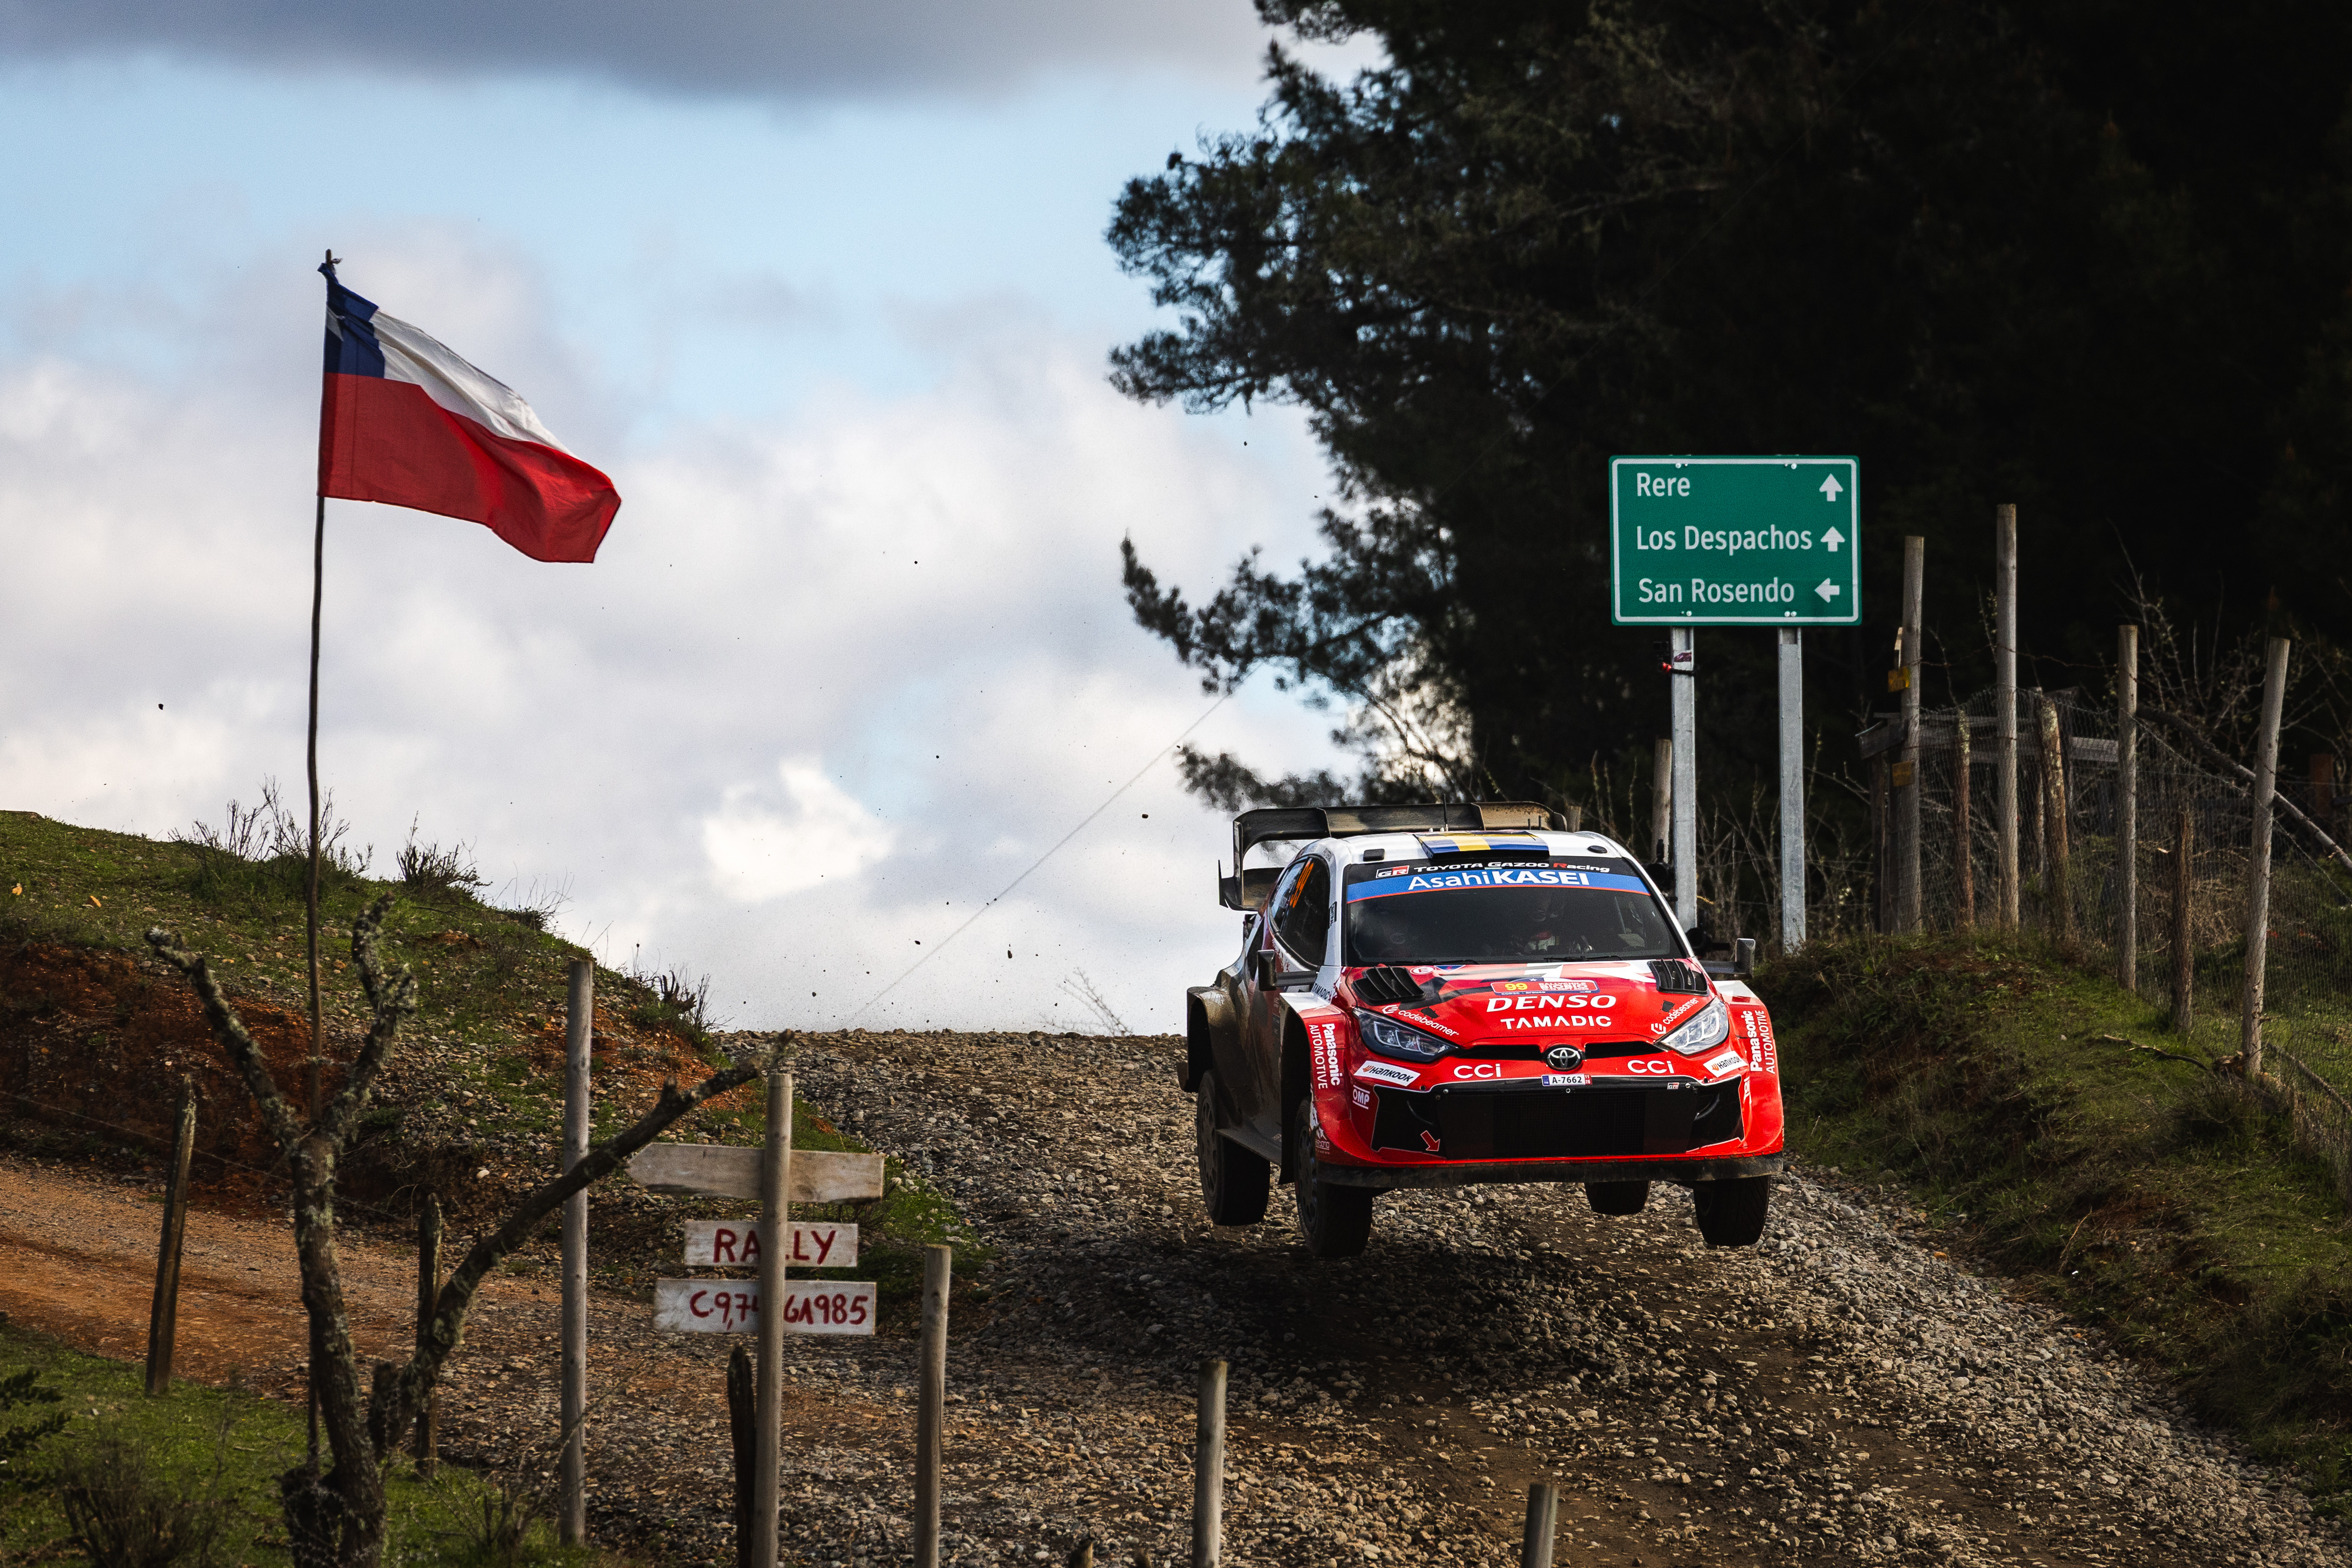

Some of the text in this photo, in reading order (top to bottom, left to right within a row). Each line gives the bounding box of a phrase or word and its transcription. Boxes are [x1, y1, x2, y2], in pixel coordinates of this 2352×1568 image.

[1637, 472, 1691, 497] Rere
[1637, 524, 1812, 556] Los Despachos
[1638, 576, 1795, 603] San Rosendo
[1377, 869, 1408, 878] GR
[1408, 870, 1590, 891] AsahiKASEI
[1414, 863, 1483, 872] TOYOTA
[1553, 863, 1610, 873] Racing
[1311, 982, 1330, 1000] TAMADIC
[1504, 982, 1528, 991] 99
[1486, 995, 1617, 1012] DENSO
[1662, 997, 1699, 1025] codebeamer
[1398, 1010, 1457, 1036] codebeamer
[1500, 1015, 1612, 1030] TAMADIC
[1740, 1011, 1763, 1072] Panasonic
[1755, 1010, 1776, 1075] AUTOMOTIVE
[1308, 1024, 1328, 1090] AUTOMOTIVE
[1322, 1023, 1343, 1086] Panasonic
[1352, 1089, 1370, 1105] OMP
[713, 1228, 836, 1265] RALY
